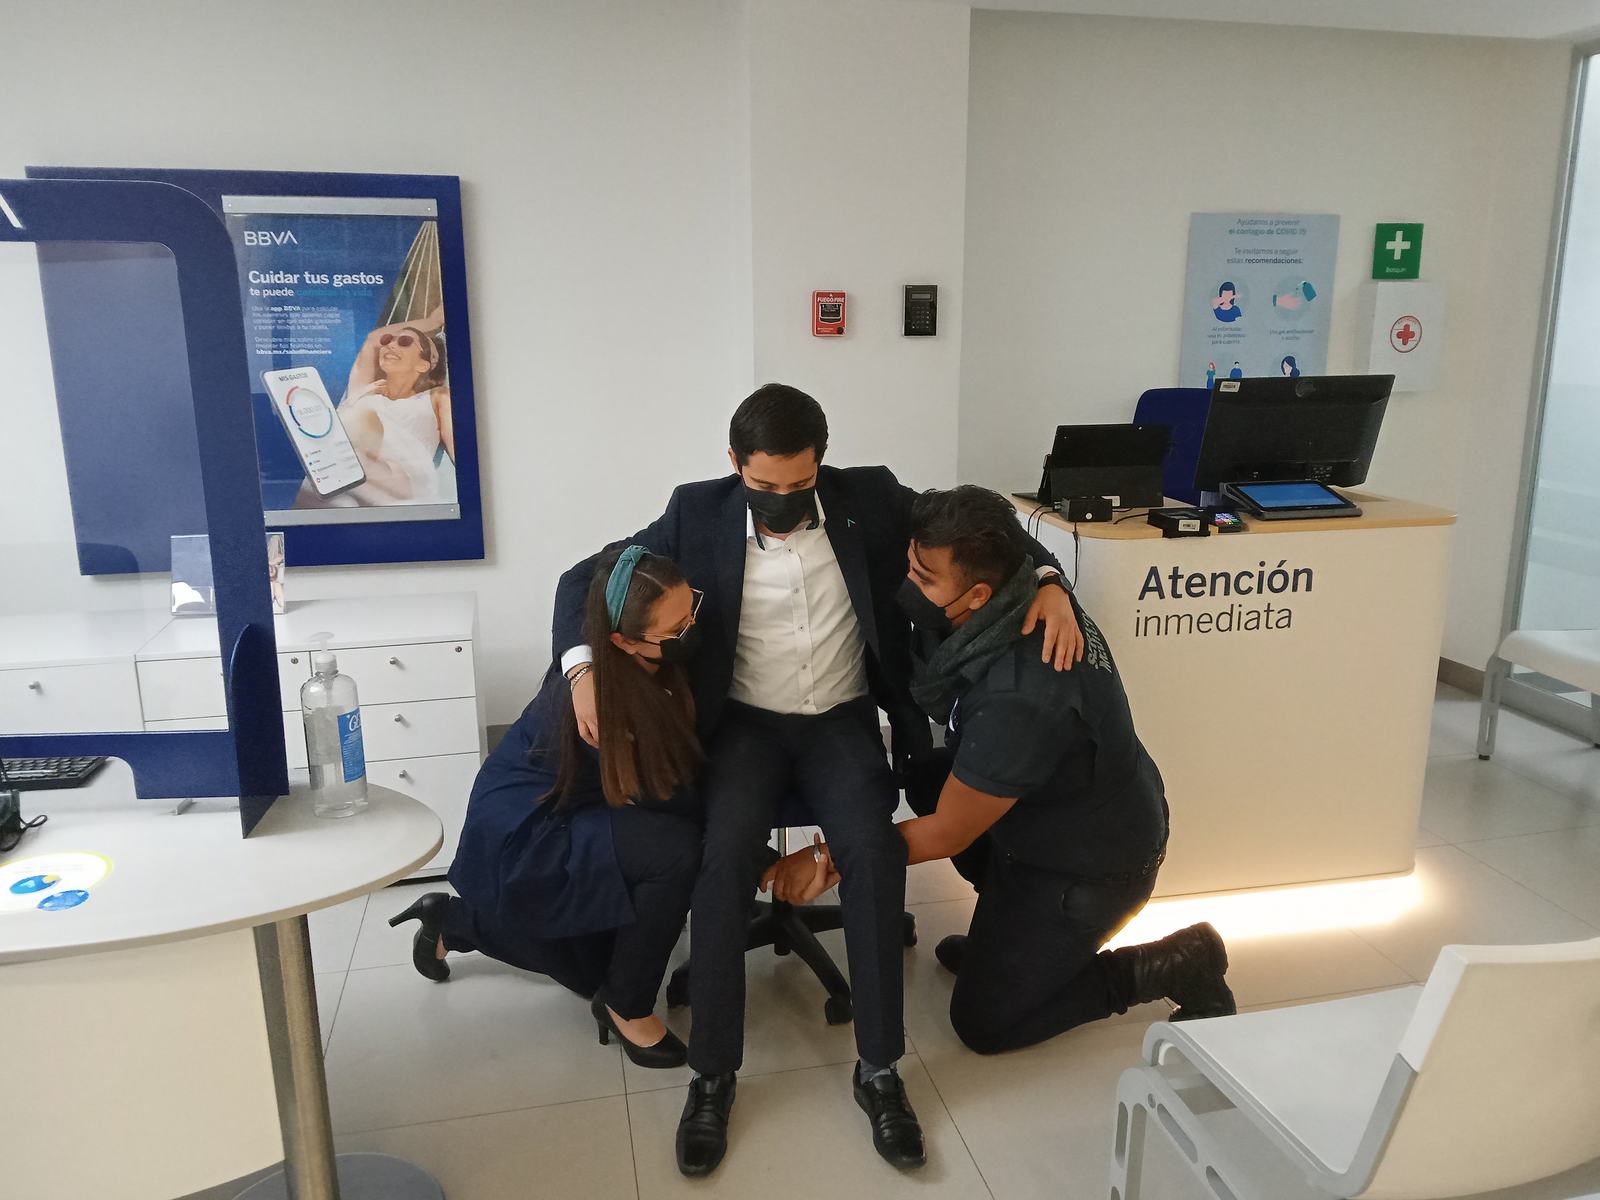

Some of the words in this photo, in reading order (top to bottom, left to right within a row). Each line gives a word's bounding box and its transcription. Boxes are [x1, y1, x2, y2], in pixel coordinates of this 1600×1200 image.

[244, 230, 298, 246] BBVA
[248, 270, 299, 284] Cuidar
[303, 271, 330, 285] tus
[332, 271, 384, 288] gastos
[249, 287, 261, 297] te
[262, 287, 295, 298] puede
[1138, 560, 1313, 600] Atención
[1135, 603, 1292, 637] inmediata
